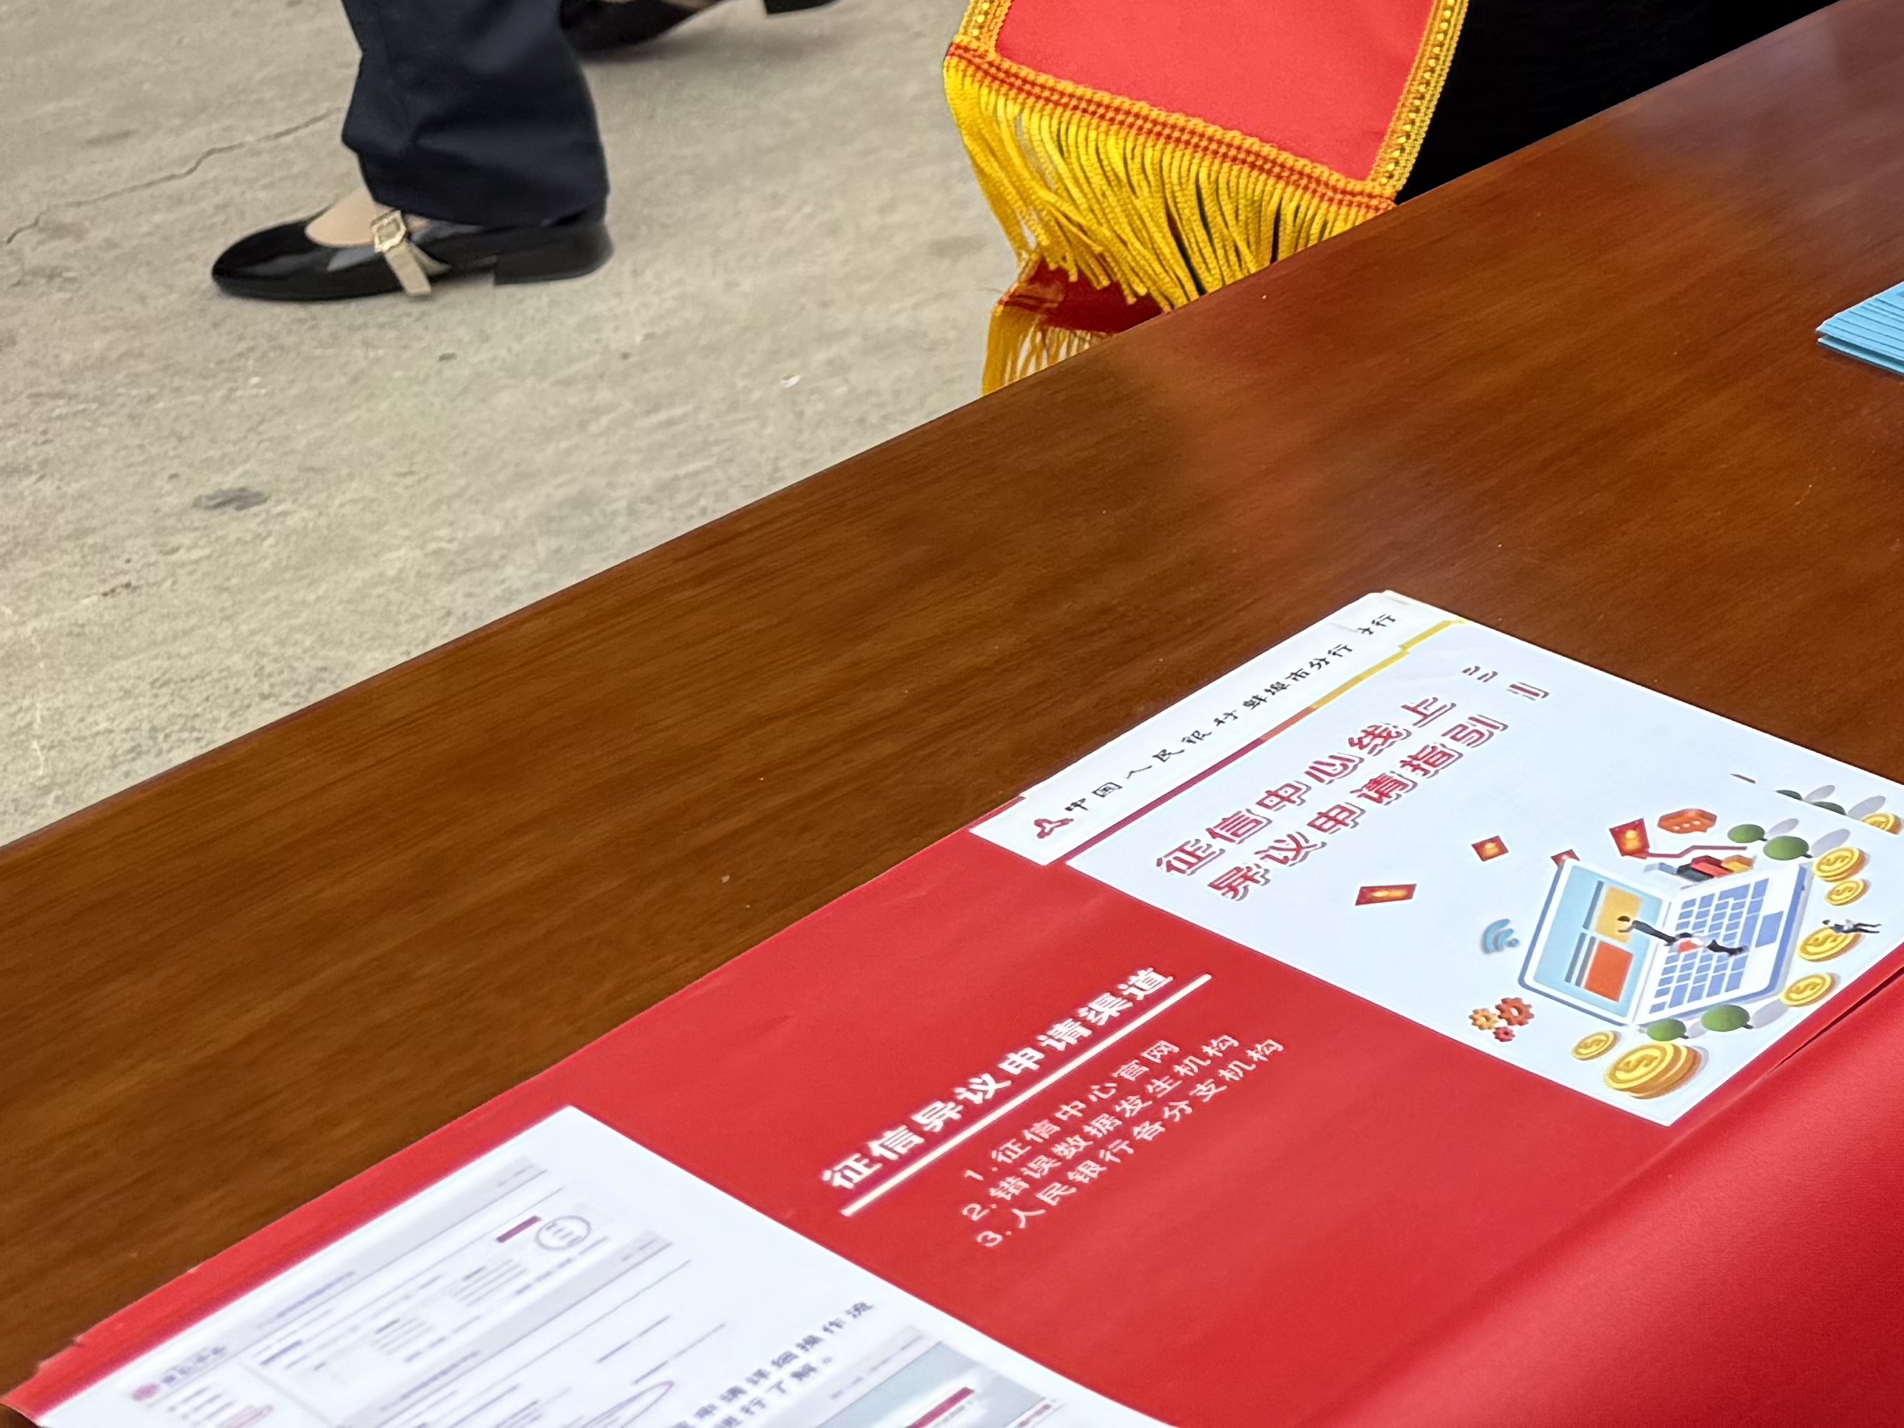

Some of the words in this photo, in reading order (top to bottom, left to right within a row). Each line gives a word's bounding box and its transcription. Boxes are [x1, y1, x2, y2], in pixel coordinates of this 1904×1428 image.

[1063, 644, 1354, 813] 中国人民银行蚌埠市分行
[1155, 695, 1458, 878] 征信中心线上
[1207, 714, 1510, 902] 异议申请指引
[820, 966, 1174, 1191] 征信异议申请渠道
